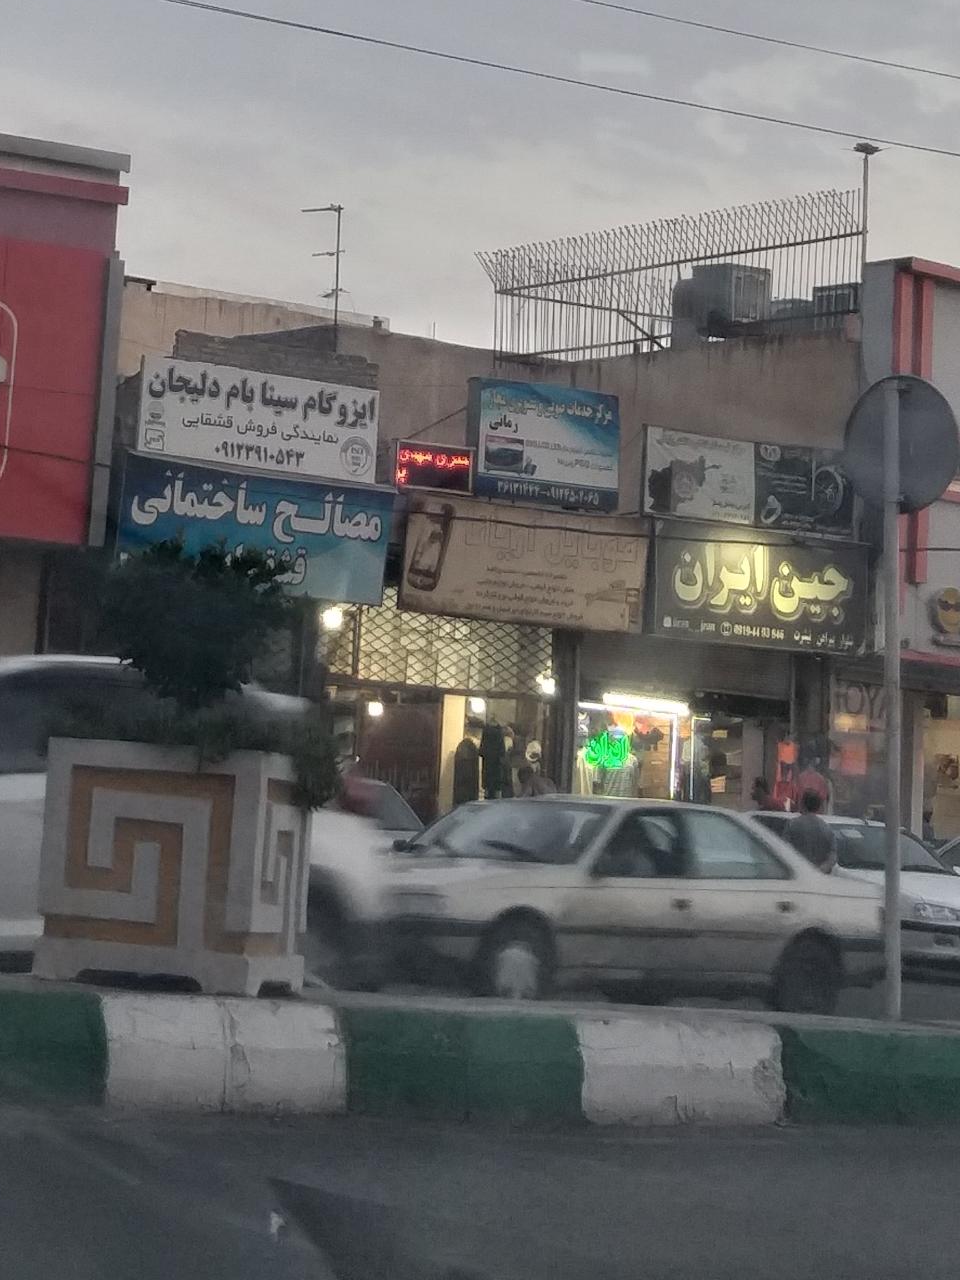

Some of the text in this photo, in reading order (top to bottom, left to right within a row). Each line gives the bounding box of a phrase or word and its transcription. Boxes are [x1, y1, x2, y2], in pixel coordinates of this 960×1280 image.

[148, 368, 221, 403] دلیجان
[224, 377, 257, 413] بام
[259, 378, 299, 417] سینا
[182, 411, 340, 446] نمایندگی فروش قشقایی
[489, 415, 519, 433] رمانی
[131, 470, 382, 544] مصالح ساختمانی
[673, 543, 850, 618] جین ایران
